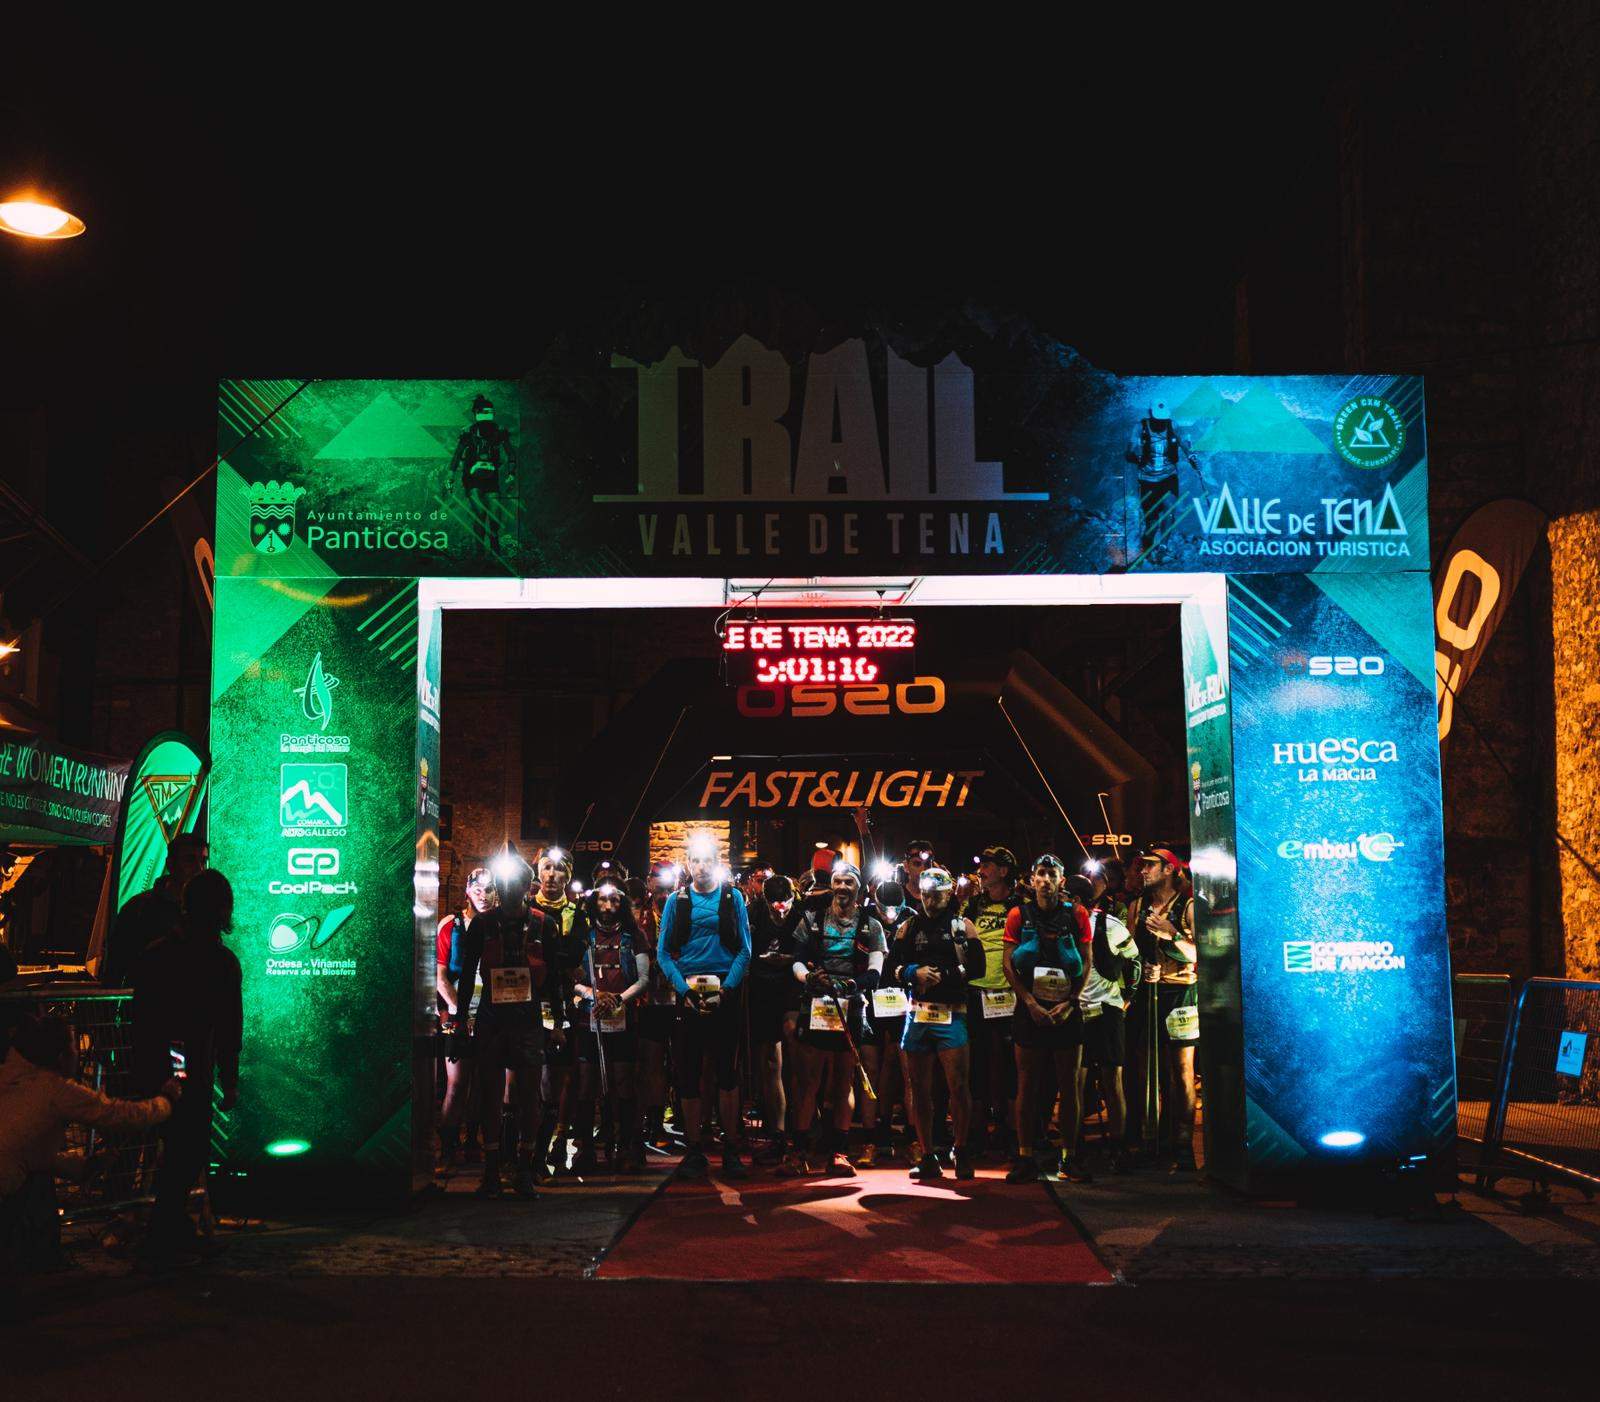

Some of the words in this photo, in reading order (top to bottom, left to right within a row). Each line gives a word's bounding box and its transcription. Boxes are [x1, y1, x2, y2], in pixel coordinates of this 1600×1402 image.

[610, 333, 1003, 499] TRAIL
[1336, 401, 1358, 430] GREEN
[1384, 403, 1402, 430] TRAIL
[307, 510, 421, 521] Ayuntamiento
[432, 509, 448, 521] de
[1192, 481, 1281, 535] VALLE
[1288, 513, 1316, 535] DE
[1320, 482, 1408, 535] TENA
[307, 526, 448, 550] Panticosa
[638, 513, 780, 556] VALLE
[808, 513, 859, 555] DE
[886, 512, 1004, 555] TENA
[1200, 540, 1311, 556] ASOCIACION
[1318, 541, 1410, 557] TURISTICA
[722, 626, 745, 649] E
[750, 626, 783, 649] DE
[788, 626, 851, 649] TENA
[856, 625, 915, 648] 2022
[281, 734, 350, 745] Panticosa
[17, 745, 75, 791] WOMEN
[698, 770, 985, 809] FAST&LIGHT
[1277, 838, 1358, 860] embou
[268, 881, 358, 895] CoolPack
[266, 958, 302, 969] Ordesa
[266, 968, 298, 976] Reserva
[301, 967, 310, 976] de
[312, 967, 320, 976] la
[322, 967, 356, 976] Biosfera
